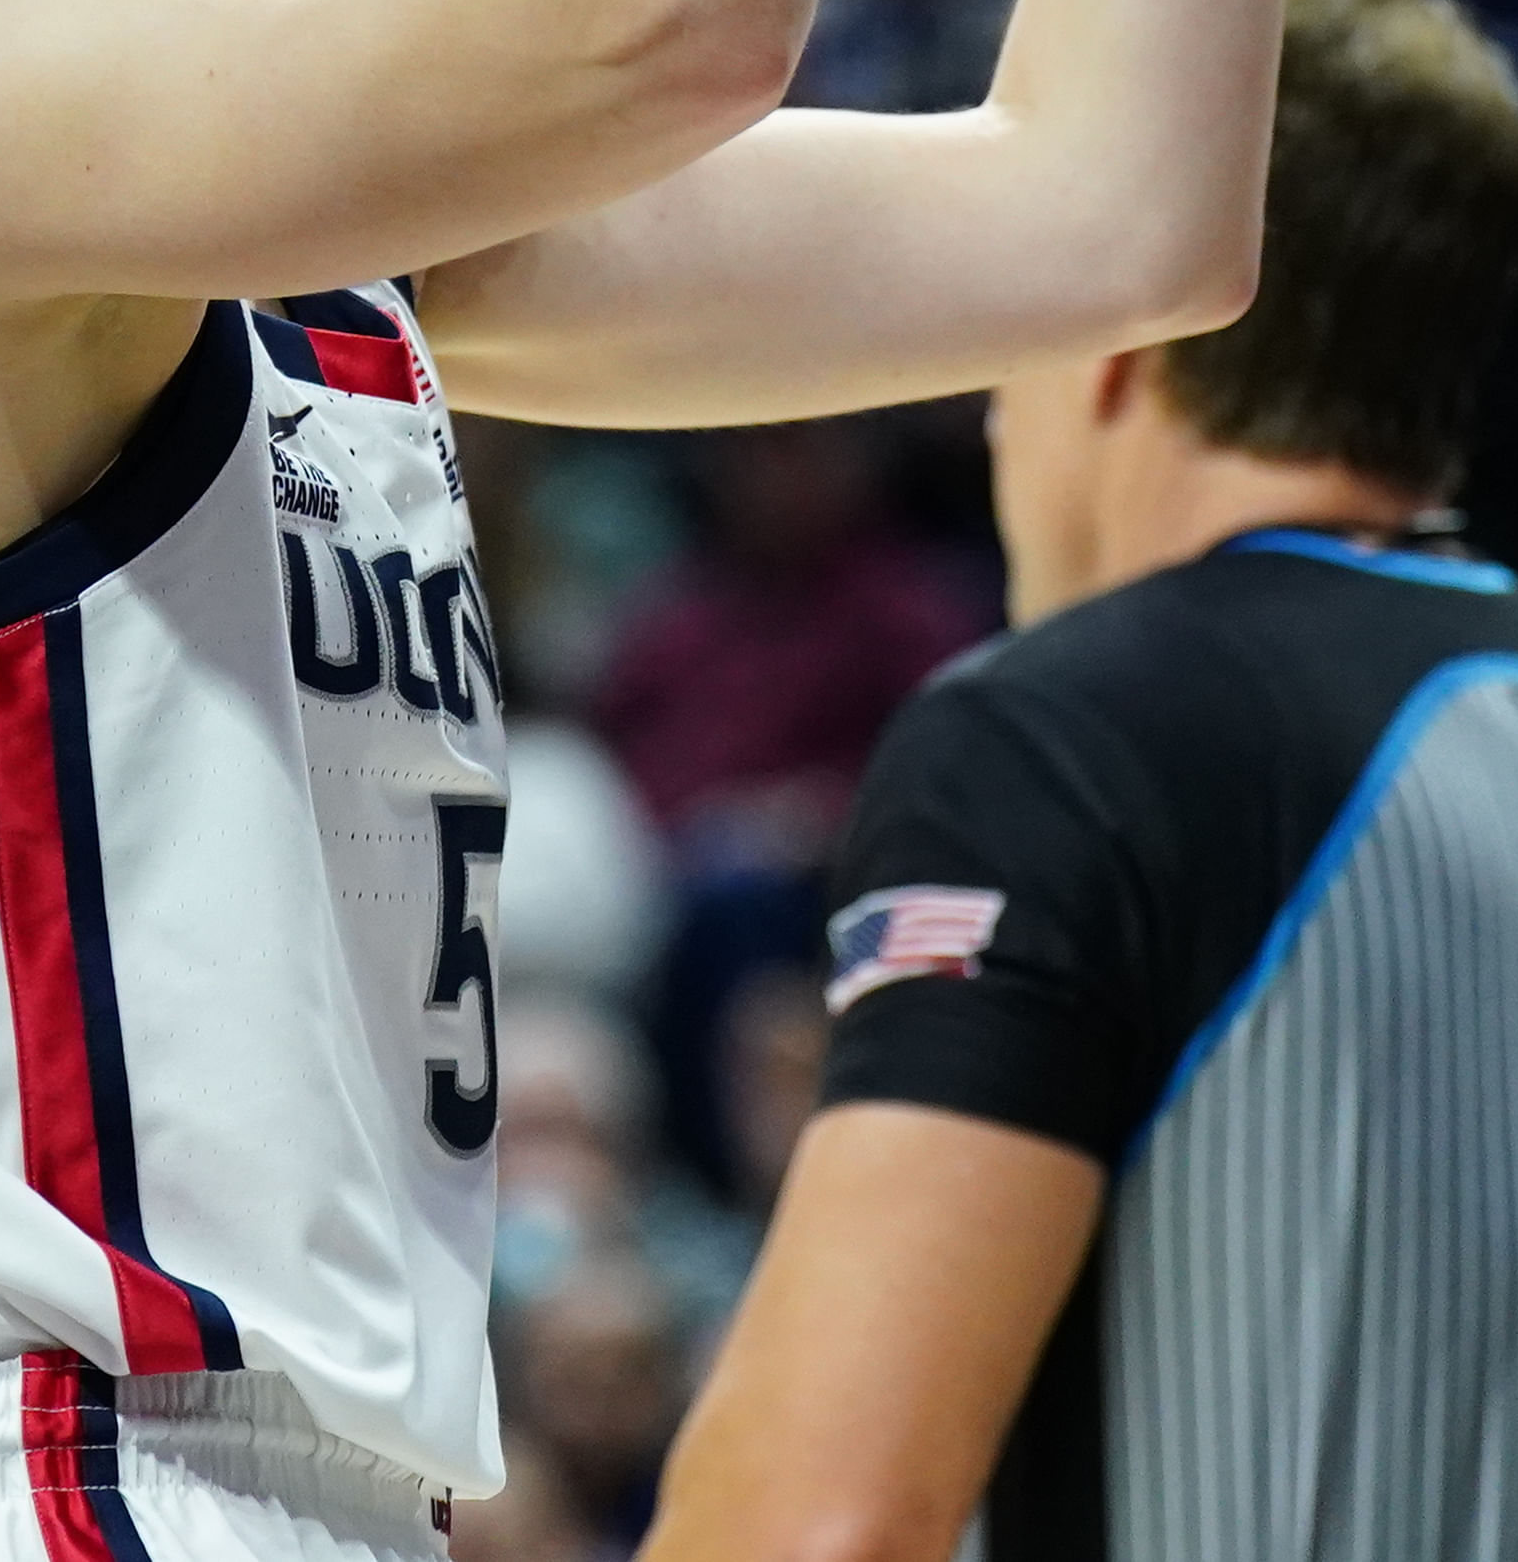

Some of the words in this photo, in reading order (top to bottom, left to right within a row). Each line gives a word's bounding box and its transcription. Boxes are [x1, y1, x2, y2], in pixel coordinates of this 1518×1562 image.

[269, 442, 299, 477] BE
[272, 473, 340, 524] CHANGE
[424, 792, 510, 1161] 5
